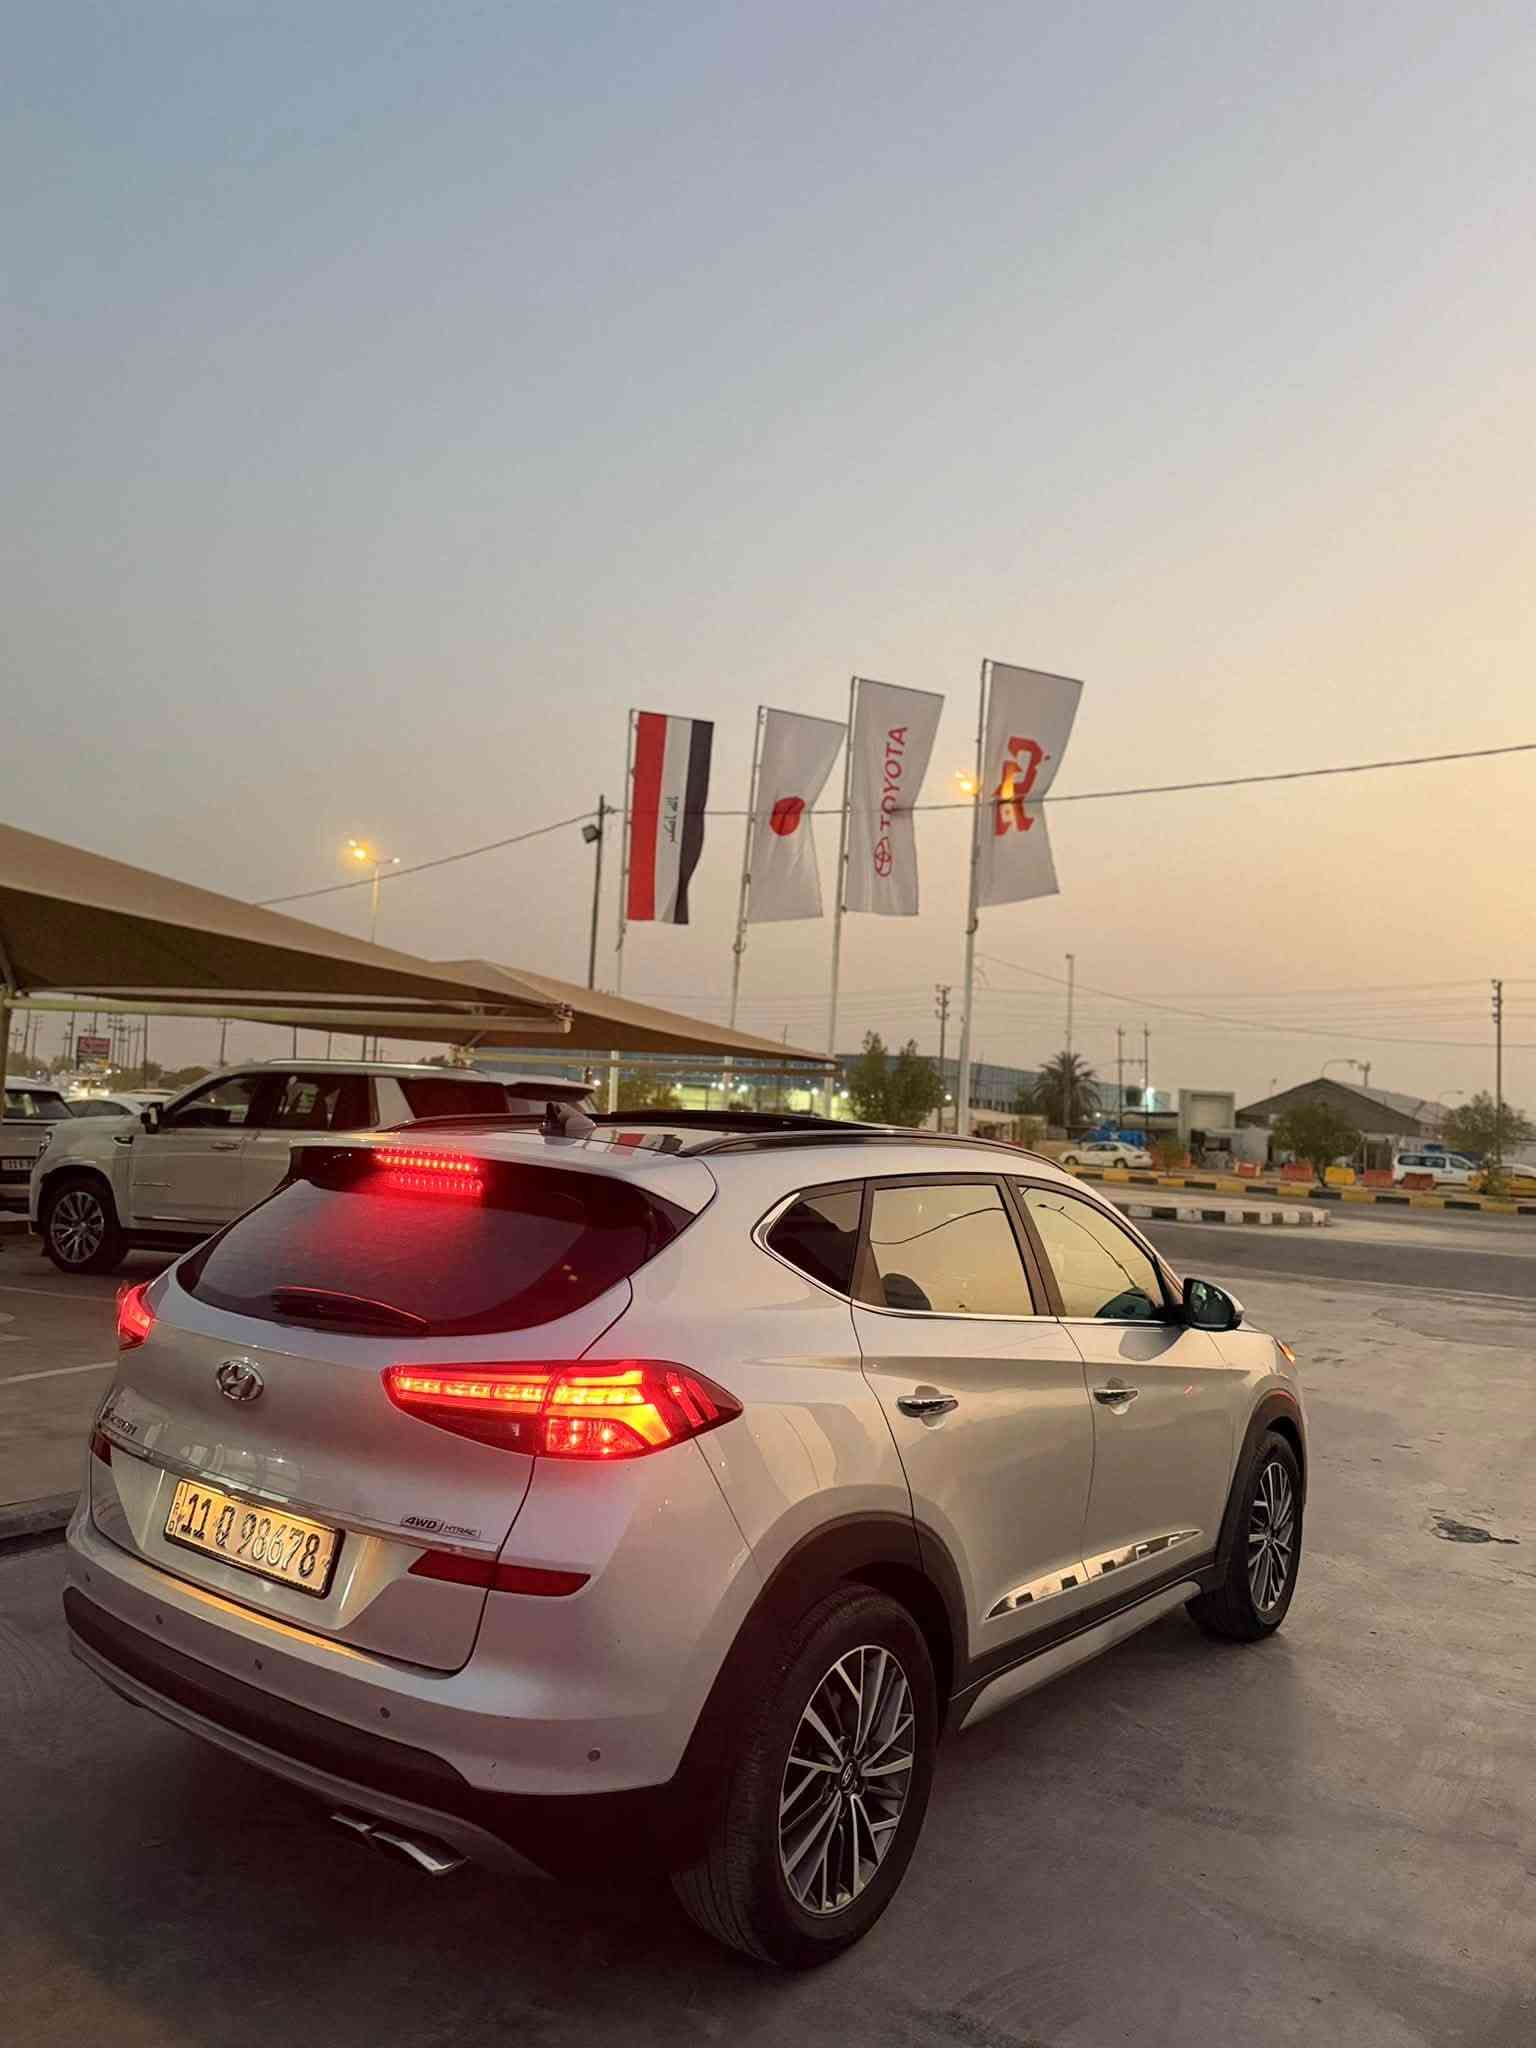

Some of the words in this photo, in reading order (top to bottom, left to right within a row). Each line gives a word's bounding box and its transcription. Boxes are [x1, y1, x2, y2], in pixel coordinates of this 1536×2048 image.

[880, 727, 908, 831] TOYOTA
[181, 1493, 212, 1540] 11
[404, 1515, 437, 1529] 4WD
